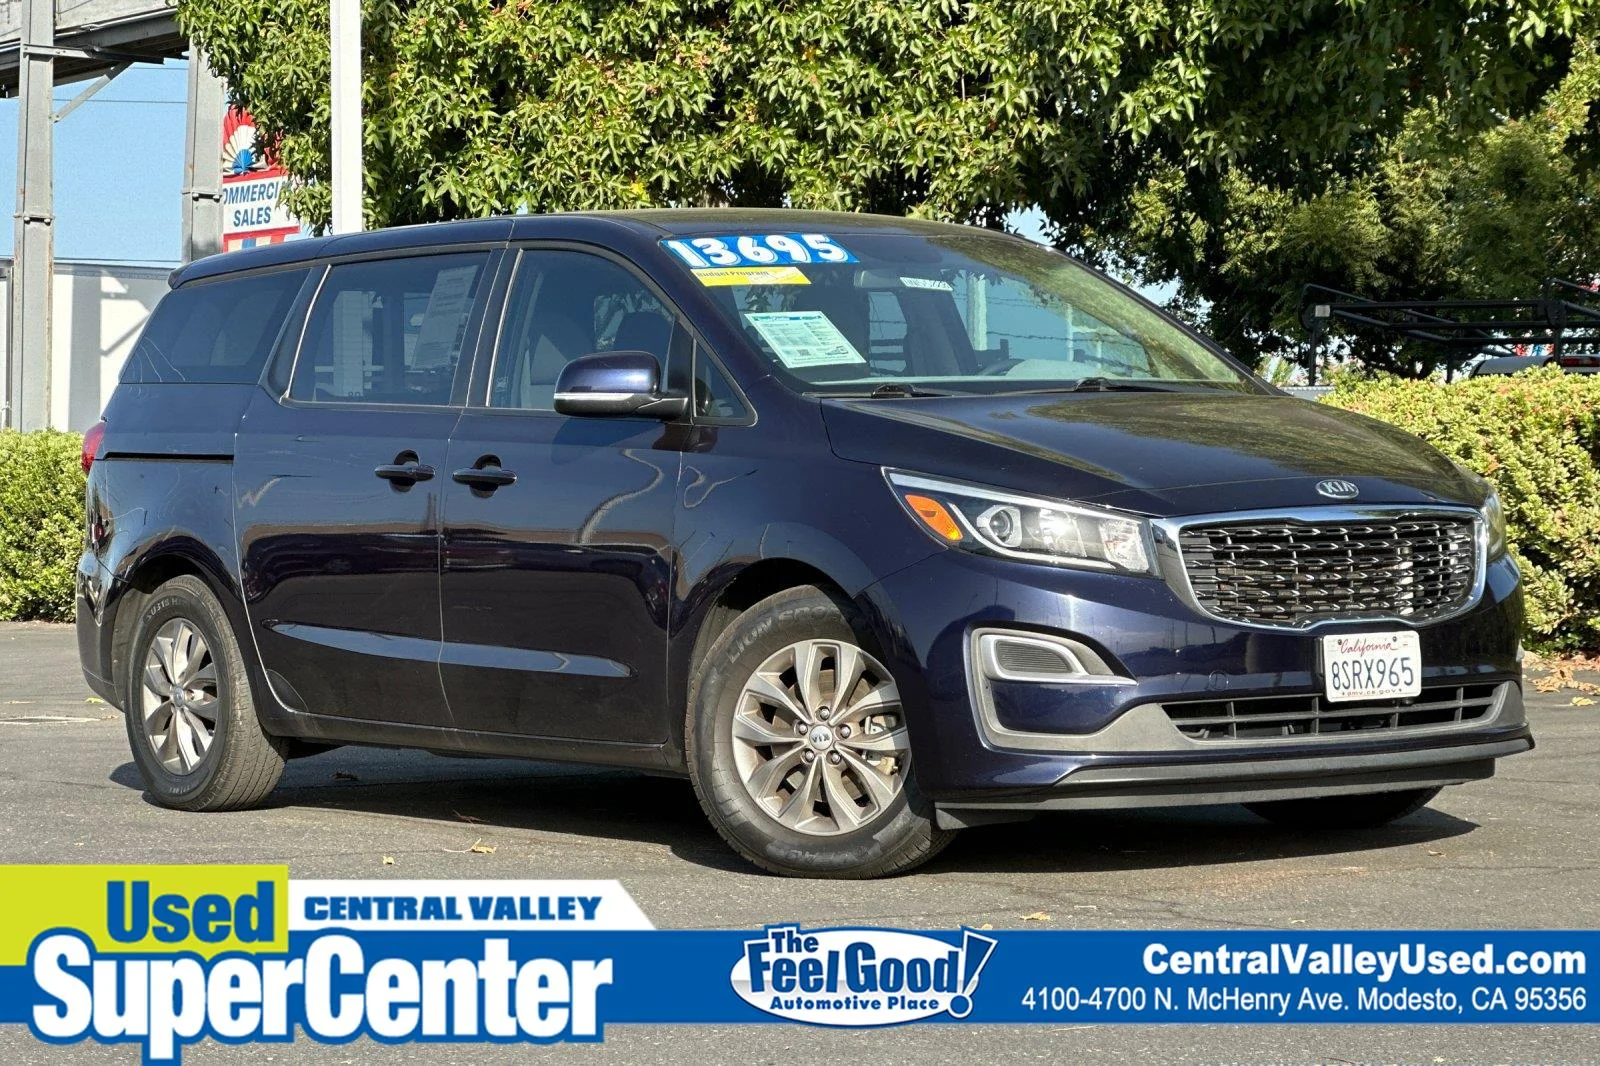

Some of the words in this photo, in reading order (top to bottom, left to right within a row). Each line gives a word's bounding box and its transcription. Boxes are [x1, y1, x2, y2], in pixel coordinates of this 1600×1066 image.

[223, 181, 287, 205] OMMERCI
[233, 206, 272, 228] SALES
[664, 233, 849, 265] 13695
[1322, 480, 1355, 494] KIA
[1340, 637, 1398, 658] California
[1331, 656, 1414, 691] 8SRX965
